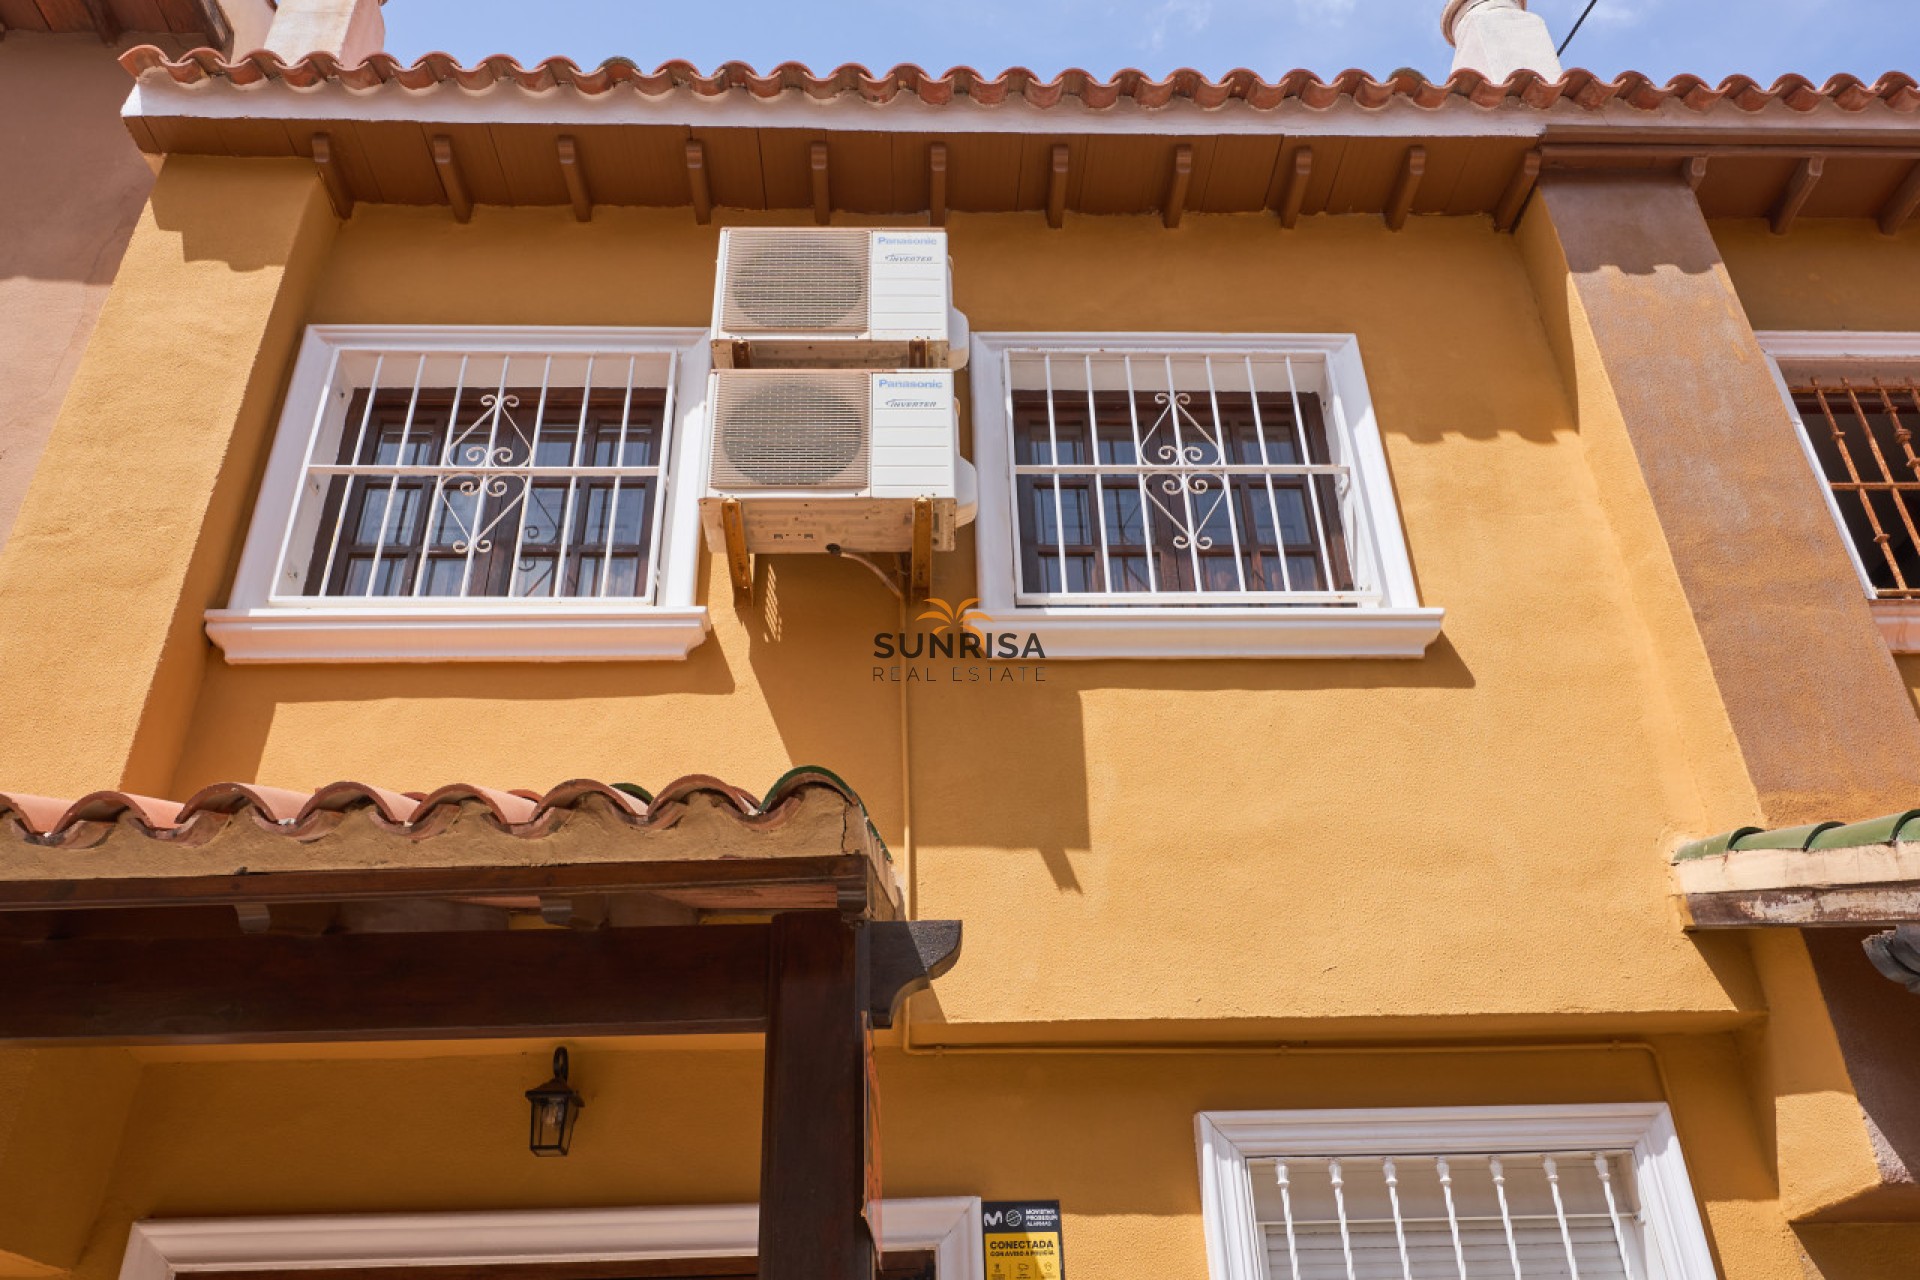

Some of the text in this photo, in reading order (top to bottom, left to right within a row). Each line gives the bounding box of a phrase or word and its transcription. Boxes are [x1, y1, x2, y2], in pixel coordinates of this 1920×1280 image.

[878, 236, 937, 245] Panasonic
[879, 379, 943, 388] Panasonic
[989, 1240, 1054, 1250] CONECTADA
